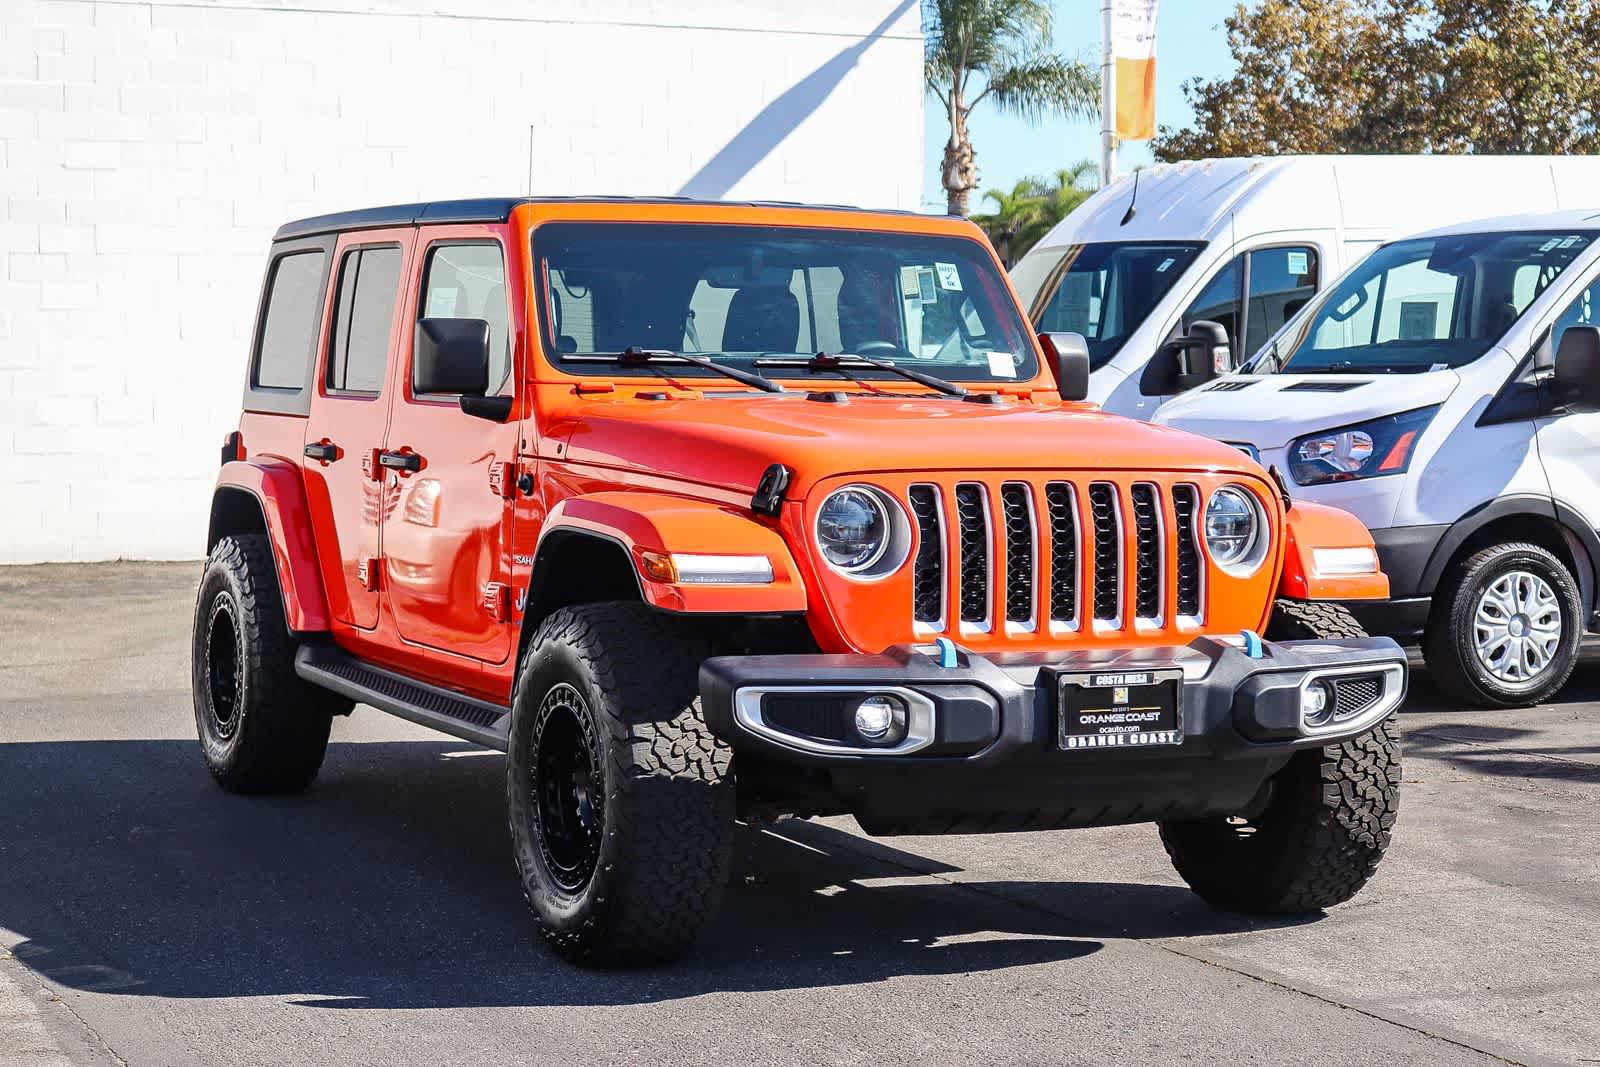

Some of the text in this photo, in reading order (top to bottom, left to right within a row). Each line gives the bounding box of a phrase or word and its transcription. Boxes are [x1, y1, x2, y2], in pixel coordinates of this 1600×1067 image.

[1096, 673, 1148, 686] COSTA MESA
[1079, 711, 1161, 724] ORANGE COAST
[1099, 725, 1140, 734] ocauto.com
[1068, 732, 1176, 748] ORANGE COAST
